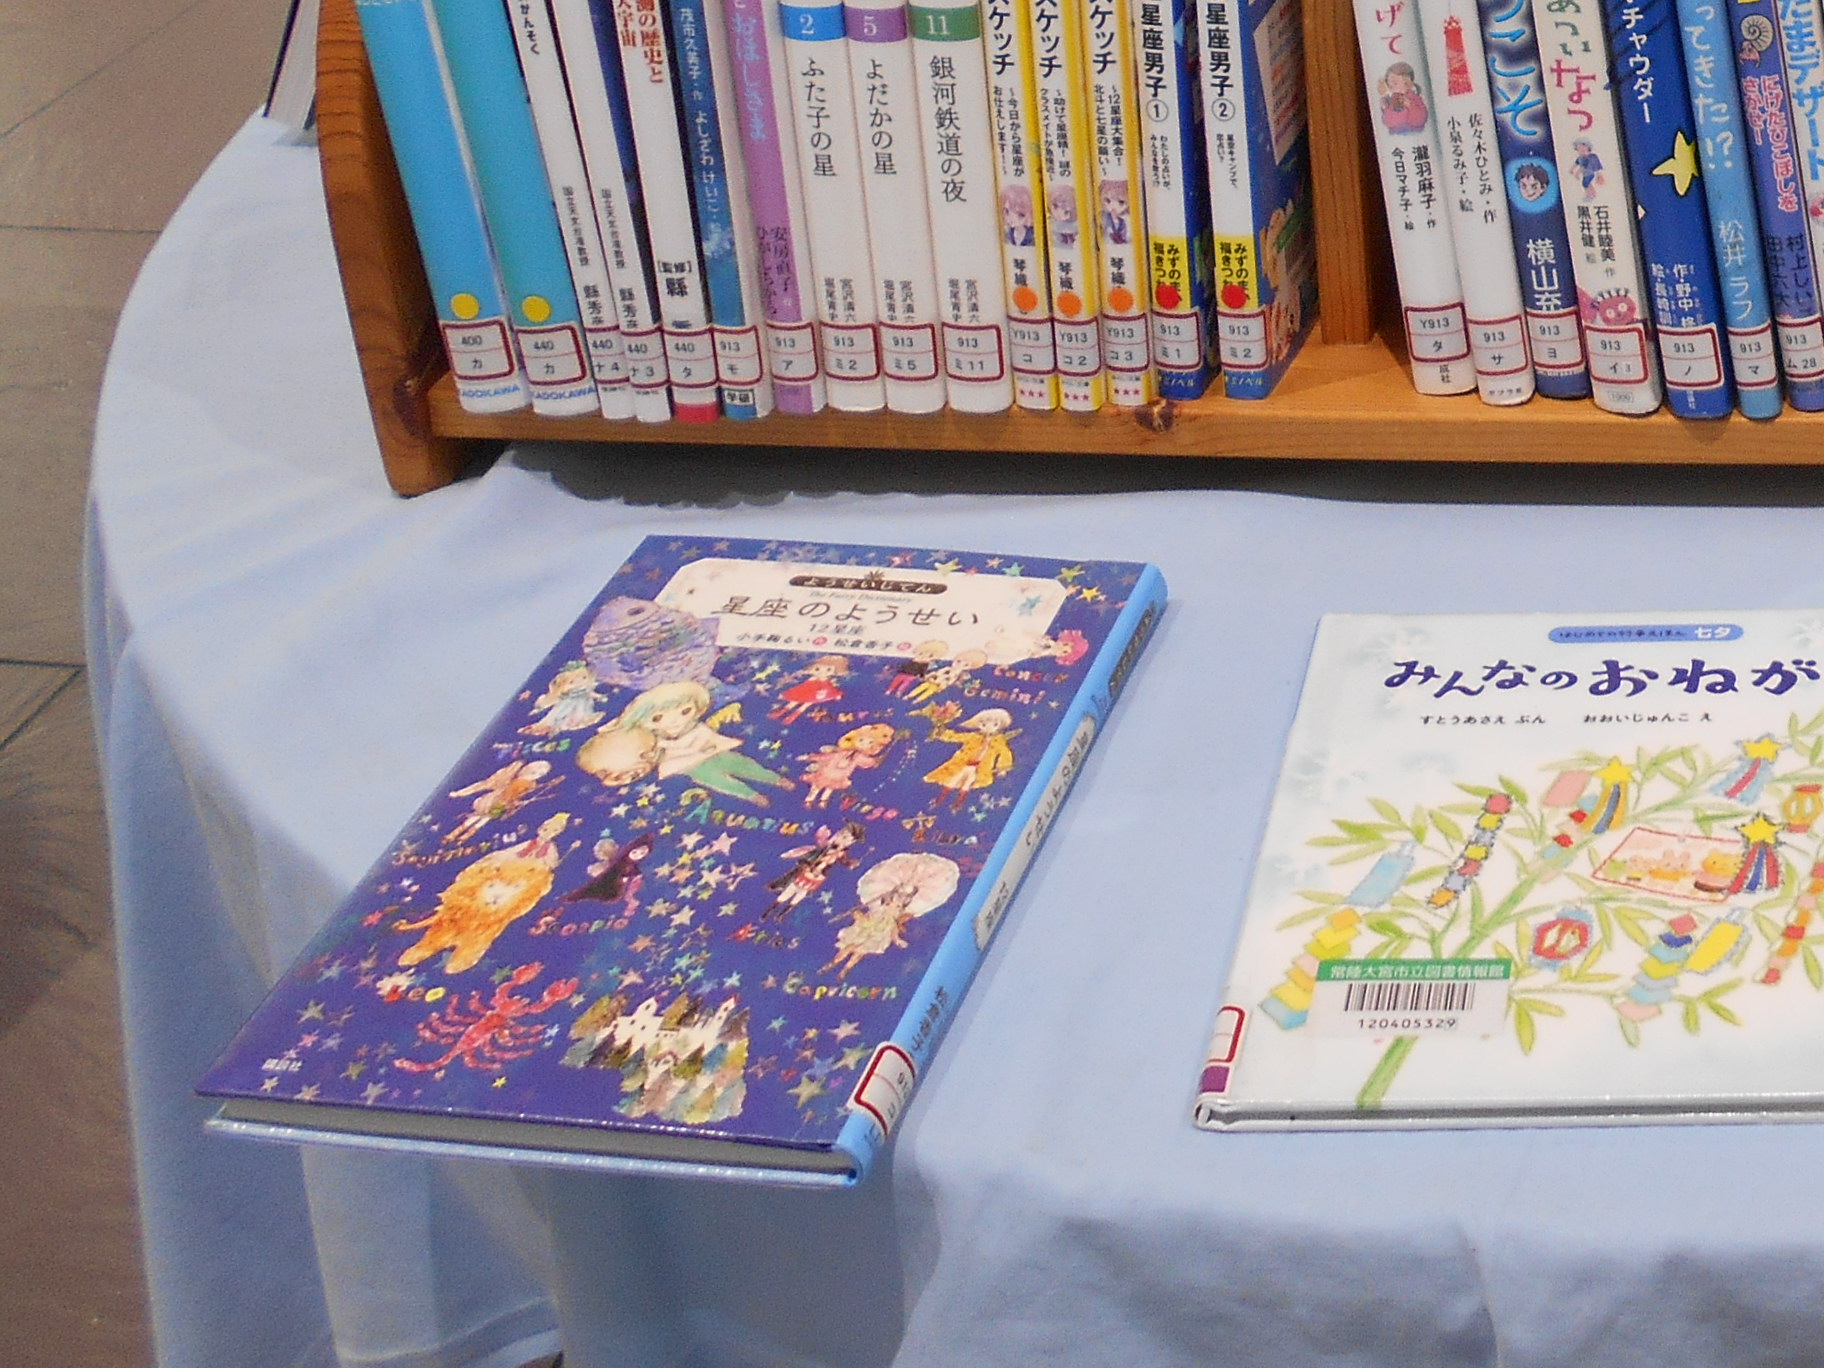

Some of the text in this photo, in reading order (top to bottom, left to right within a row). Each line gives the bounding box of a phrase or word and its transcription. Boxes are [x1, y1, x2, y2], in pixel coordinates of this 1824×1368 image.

[799, 16, 814, 34] 2
[863, 15, 877, 35] 5
[926, 15, 950, 35] 11
[801, 58, 836, 177] ふた子の星
[865, 58, 897, 176] よだかの星
[929, 55, 967, 204] 銀河鉄道の夜
[1468, 112, 1498, 224] 佐々木ひとみ・作
[1419, 317, 1450, 330] Y913
[1539, 324, 1561, 336] 913
[1059, 332, 1088, 343] Y913
[1159, 325, 1181, 337] 913
[1228, 325, 1250, 337] 913
[1484, 330, 1506, 343] 913
[533, 339, 555, 352] 440
[592, 338, 615, 351] 440
[774, 338, 797, 351] 913
[833, 337, 855, 348] 913
[893, 337, 914, 348] 913
[956, 337, 978, 349] 913
[1432, 340, 1444, 352] タ
[1600, 339, 1622, 352] 913
[1785, 334, 1807, 346] 913
[627, 342, 649, 355] 440
[674, 341, 695, 354] 440
[719, 341, 741, 353] 913
[1673, 340, 1695, 354] 913
[1740, 341, 1763, 354] 913
[1491, 353, 1505, 365] サ
[543, 363, 556, 375] カ
[1748, 364, 1760, 376] マ
[802, 575, 933, 595] ようせいじてん
[710, 595, 981, 627] 星座のようせい
[1694, 624, 1732, 640] 七夕
[1419, 713, 1506, 726] すとうあさえ
[1515, 713, 1547, 726] ぶん
[1583, 711, 1691, 725] おおいじゅんこ
[1357, 1018, 1457, 1029] 120405329
